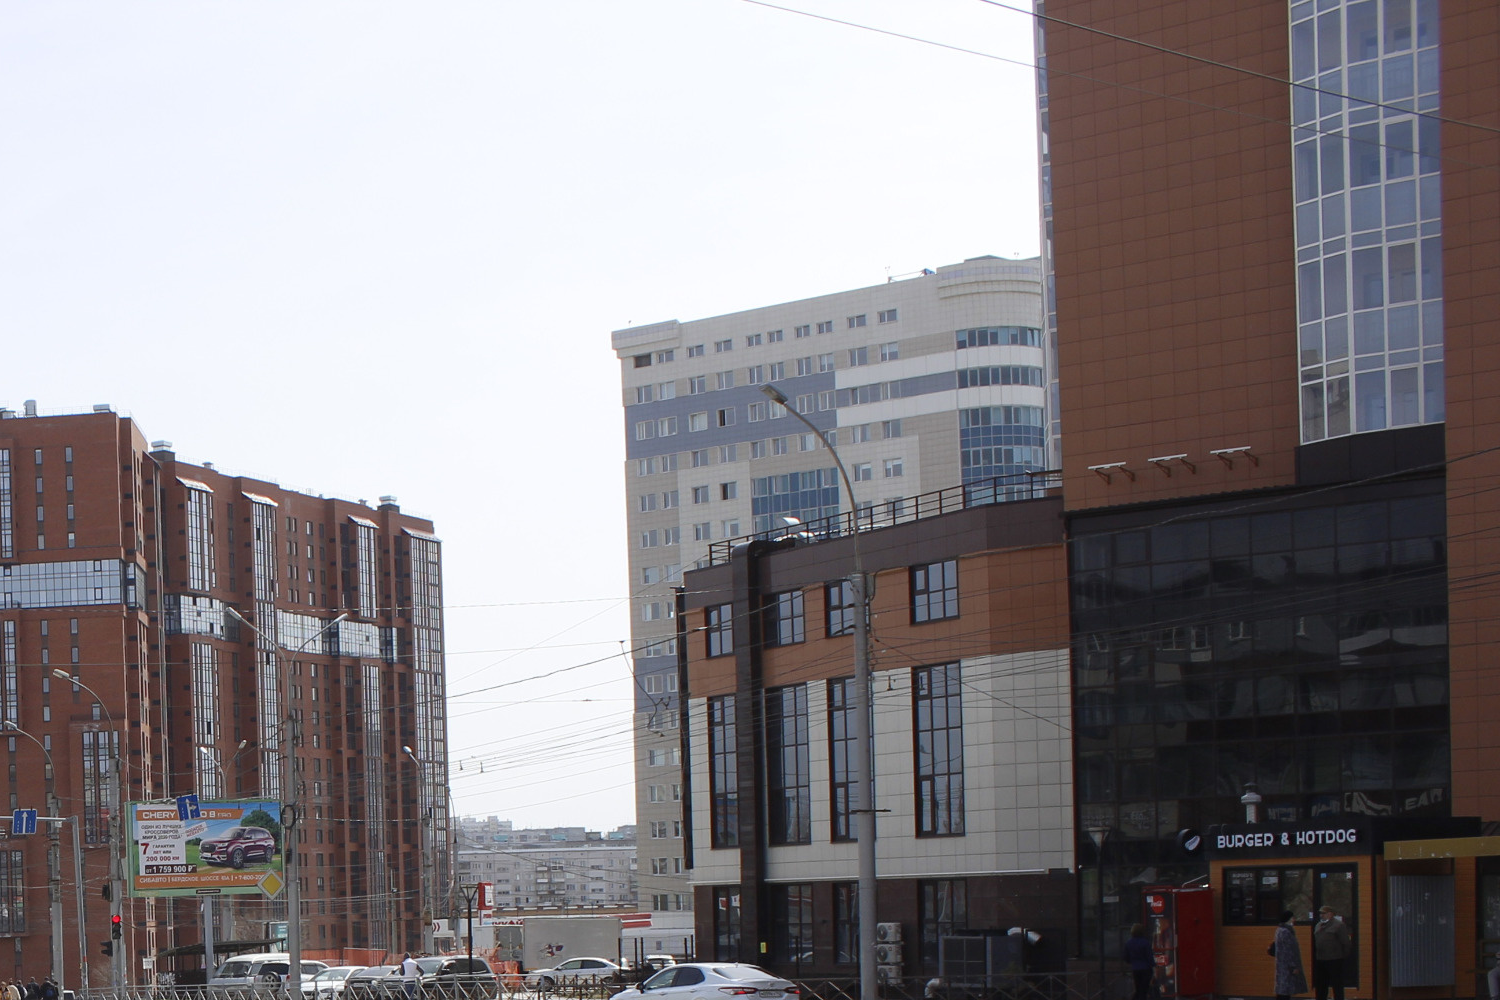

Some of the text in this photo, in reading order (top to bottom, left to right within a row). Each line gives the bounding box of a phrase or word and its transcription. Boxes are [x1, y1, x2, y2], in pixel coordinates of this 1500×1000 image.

[142, 811, 176, 819] CHERY
[209, 810, 216, 818] 8
[1217, 829, 1357, 849] BURGER & HOTDOG
[140, 842, 149, 855] 7
[159, 865, 172, 873] 759
